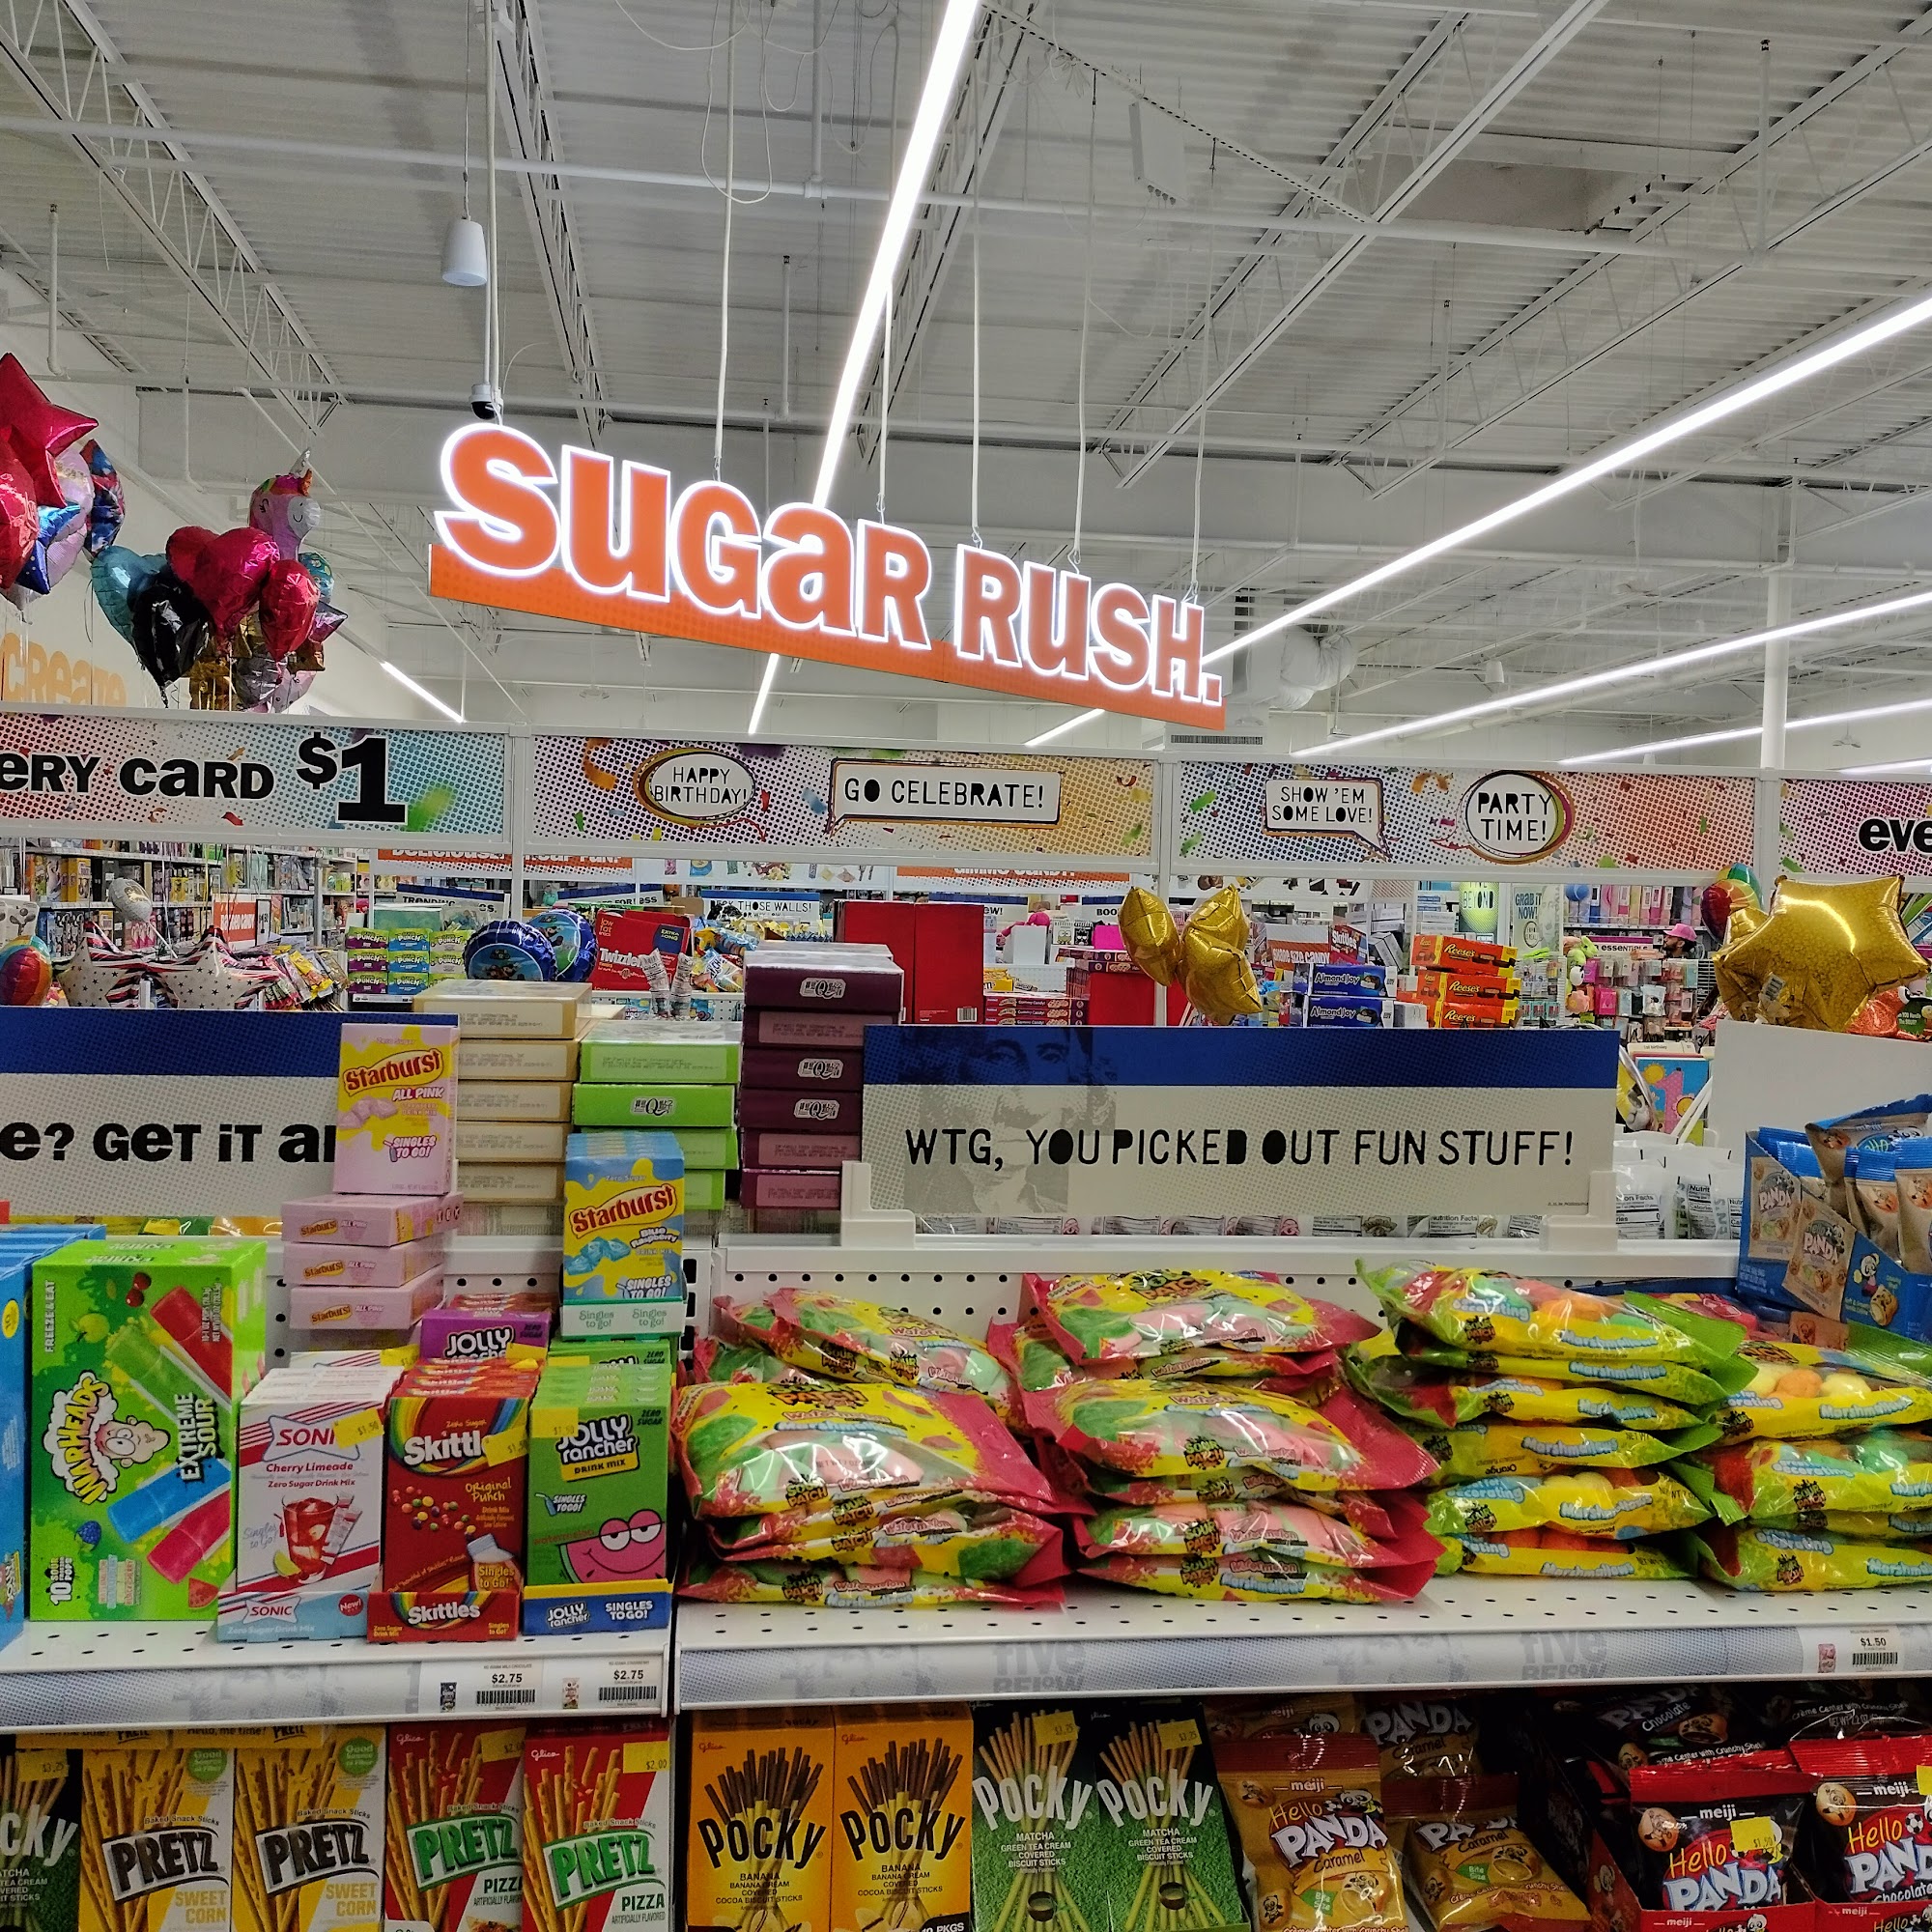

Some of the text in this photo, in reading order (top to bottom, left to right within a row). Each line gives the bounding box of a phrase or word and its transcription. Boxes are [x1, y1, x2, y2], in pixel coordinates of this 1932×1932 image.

[297, 731, 408, 824] $1
[672, 766, 730, 783] HAPPY
[654, 785, 749, 805] BIRTHDAY!
[844, 777, 1045, 809] GO CELEBRATE!
[1280, 785, 1330, 803] SHOW
[1477, 791, 1553, 814] PARTY
[1271, 805, 1373, 823] SOME LOVE!
[1479, 817, 1548, 841] TIME!
[738, 901, 771, 911] THOSE
[775, 901, 811, 912] WALLS!
[1463, 891, 1493, 908] BEYOND
[1519, 907, 1537, 919] NOW!
[600, 948, 641, 967] Twizzle
[1315, 972, 1359, 984] Almond Joy
[1310, 1007, 1356, 1018] Almond Joy
[344, 1049, 442, 1092] Starburst
[392, 1089, 413, 1101] ALL
[414, 1087, 444, 1099] PINK
[392, 1135, 437, 1149] SINGLES
[905, 1128, 1573, 1172] WTG, YOU PICKED OUT FUN STUFF!
[396, 1146, 433, 1158] TO GO!
[573, 1187, 673, 1233] Starburst
[45, 1280, 55, 1300] EAT
[626, 1276, 672, 1291] SINGLES
[580, 1311, 614, 1321] Singles
[633, 1309, 667, 1320] Singles
[44, 1312, 55, 1352] FREEZE
[447, 1327, 512, 1354] JOLLY
[195, 1398, 218, 1457] SOUR
[357, 1420, 380, 1436] $1.50
[637, 1417, 663, 1426] SUGAR
[56, 1376, 110, 1505] WARHEADS
[174, 1393, 201, 1481] EXTREME
[404, 1430, 486, 1464] Skittl
[563, 1437, 634, 1463] rancher
[1184, 1440, 1218, 1455] SOUR
[1185, 1449, 1224, 1466] PATCH
[267, 1463, 304, 1474] Cherry
[306, 1462, 354, 1471] Limeade
[288, 1481, 314, 1490] Sugar
[471, 1491, 505, 1503] Punch
[1185, 1534, 1221, 1552] PATCH
[50, 1557, 60, 1581] SOUR
[65, 1557, 73, 1580] POPS
[478, 1566, 515, 1578] Singles
[50, 1582, 71, 1605] 10
[249, 1605, 292, 1616] SONIC
[339, 1599, 361, 1611] New!
[408, 1601, 481, 1625] Skittles
[547, 1604, 585, 1622] JOLLY
[605, 1601, 653, 1613] SINGLES
[549, 1614, 590, 1628] rancher
[1860, 1637, 1887, 1647] $1.50
[492, 1673, 523, 1684] $2.75
[613, 1670, 643, 1681] $2.75
[1365, 1700, 1472, 1746] PANDA
[1642, 1701, 1691, 1732] Chocolate
[645, 1758, 668, 1771] $2.00
[1291, 1778, 1324, 1793] meiji
[1873, 1782, 1909, 1798] meiji
[145, 1814, 220, 1826] Baked Snack Sticks
[298, 1807, 371, 1819] Baked Snack Sticks
[1269, 1802, 1322, 1829] Hello
[1699, 1804, 1737, 1820] meiji
[1016, 1832, 1055, 1841] MATCHA
[1143, 1828, 1180, 1837] MATCHA
[1848, 1818, 1902, 1853] Hello
[1001, 1841, 1071, 1852] GREEN TEA CREAM
[1128, 1838, 1155, 1847] GREEN
[1172, 1836, 1197, 1845] CREAM
[1270, 1814, 1388, 1868] PANDA
[1752, 1836, 1774, 1848] $1.50
[264, 1824, 369, 1885] PRETZ
[414, 1819, 518, 1881] PRETZ
[1018, 1851, 1055, 1860] COVERED
[1136, 1852, 1194, 1861] BISCUIT STICKS
[111, 1830, 218, 1892] PRETZ
[881, 1863, 921, 1872] BANANA
[1009, 1858, 1066, 1867] BISCUIT STICKS
[1314, 1849, 1365, 1872] Caramel
[1669, 1841, 1727, 1878] Hello
[740, 1872, 781, 1882] BANANA
[904, 1871, 930, 1880] CREAM
[325, 1883, 376, 1900] SWEET
[762, 1880, 790, 1889] CREAM
[918, 1886, 943, 1894] STICKS
[1663, 1862, 1780, 1912] PANDA
[175, 1890, 226, 1907] SWEET
[621, 1893, 666, 1912] PIZZA
[715, 1894, 803, 1905] COCOA BISCUIT STICKS
[185, 1908, 226, 1924] CORN
[336, 1899, 376, 1918] CORN
[936, 1921, 965, 1932] PKGS
